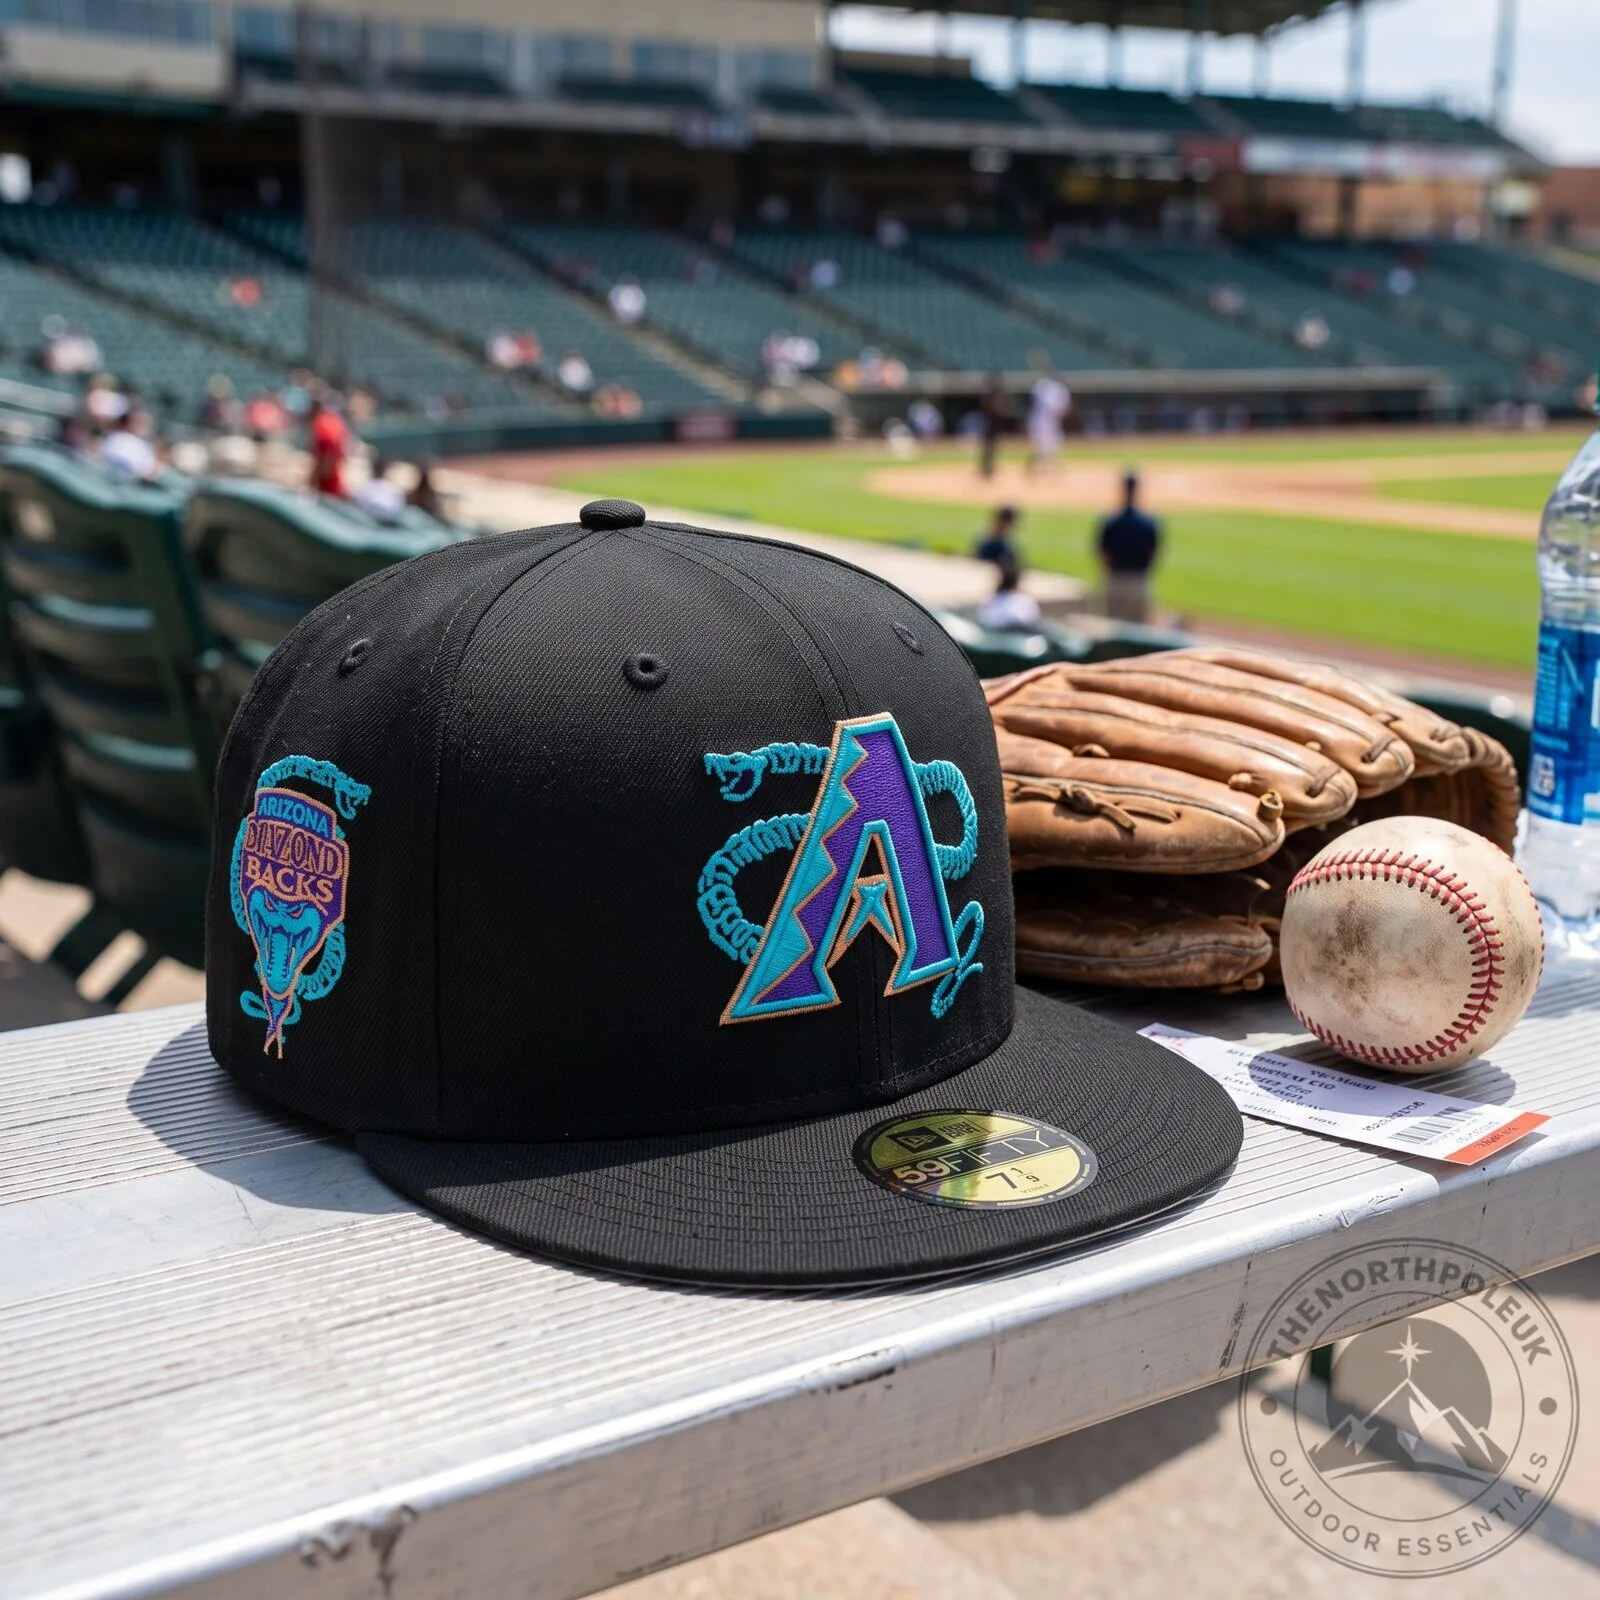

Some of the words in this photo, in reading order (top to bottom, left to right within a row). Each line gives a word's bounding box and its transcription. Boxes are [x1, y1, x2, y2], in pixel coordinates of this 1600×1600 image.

[258, 796, 330, 839] ARIZONA
[244, 855, 334, 903] BACKS
[893, 1130, 1050, 1184] 59FIFTY
[985, 1171, 1018, 1189] 7
